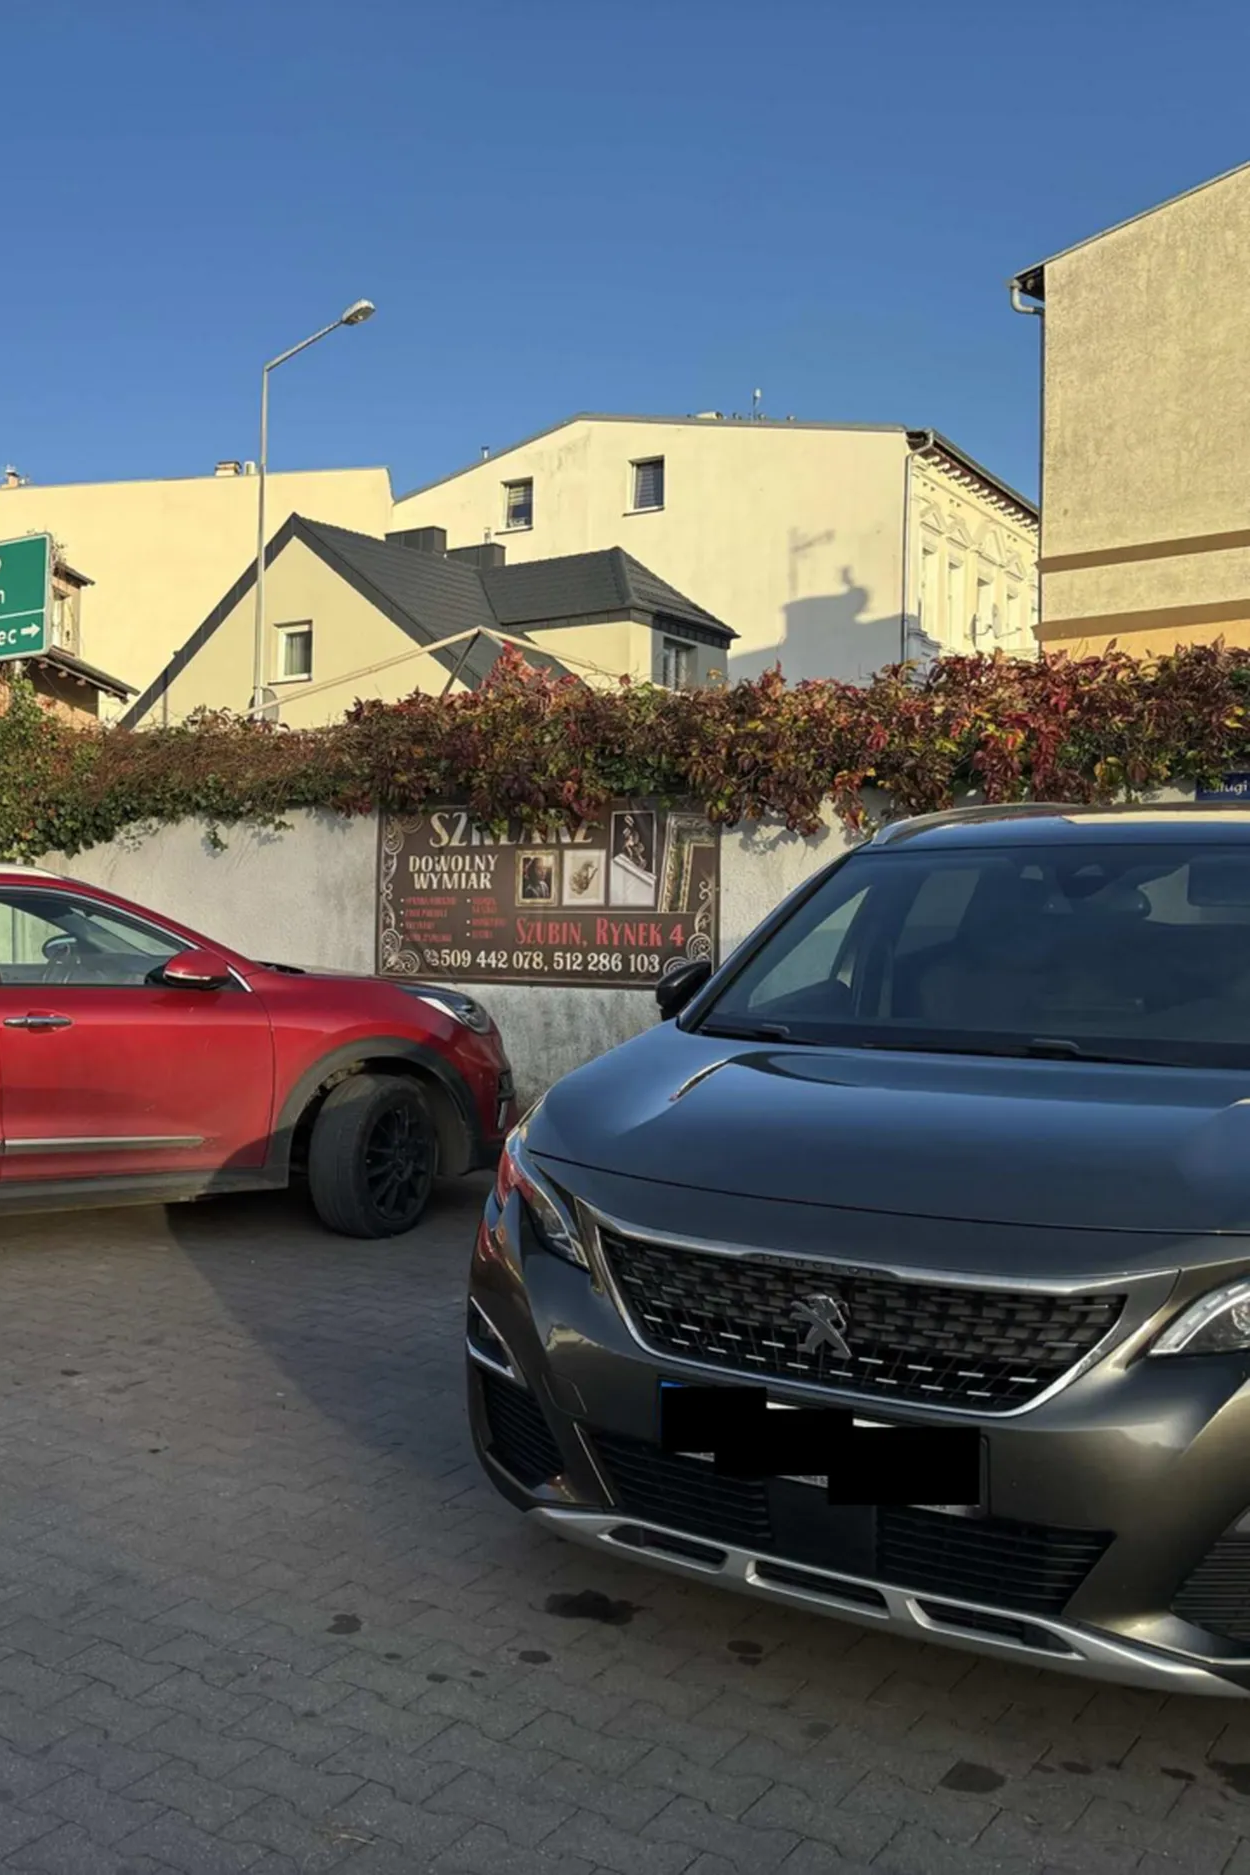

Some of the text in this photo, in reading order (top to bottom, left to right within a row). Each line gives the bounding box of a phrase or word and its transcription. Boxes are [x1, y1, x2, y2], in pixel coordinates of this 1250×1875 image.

[409, 854, 498, 872] DOWOLNY
[414, 872, 492, 890] WYMIAR
[670, 924, 685, 947] 4
[440, 949, 661, 973] 509 442 078, 512 286 103
